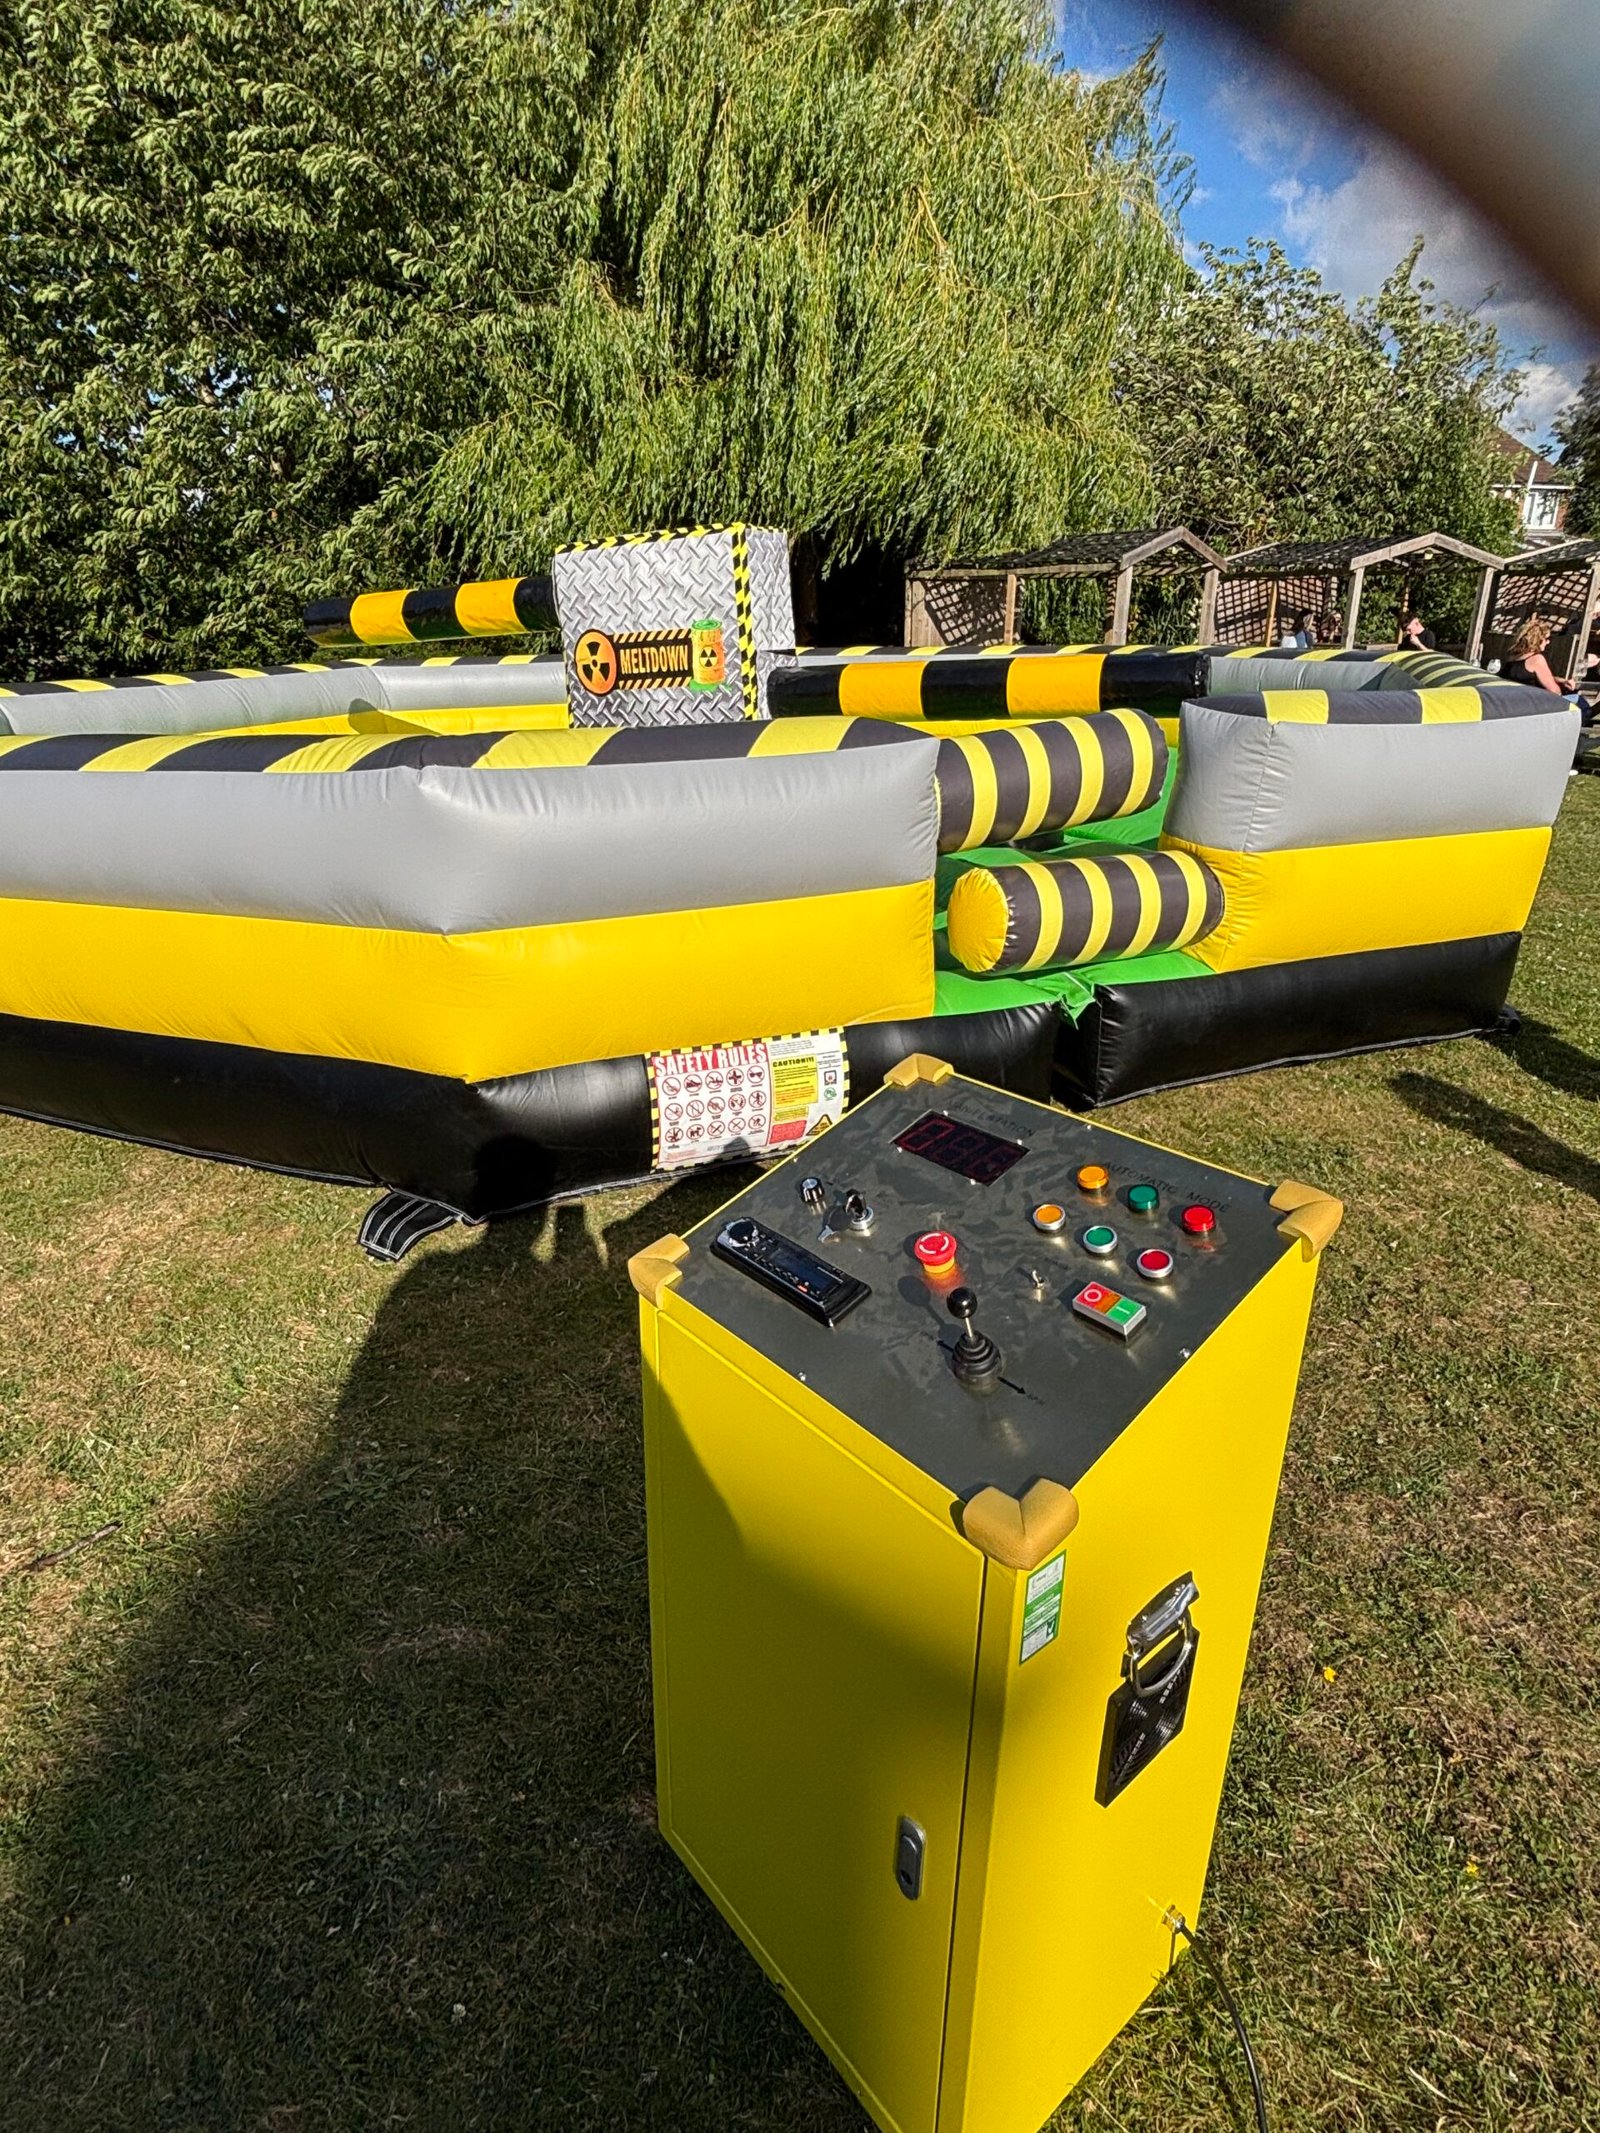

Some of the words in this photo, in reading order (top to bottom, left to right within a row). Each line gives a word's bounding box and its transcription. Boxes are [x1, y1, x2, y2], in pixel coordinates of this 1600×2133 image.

[620, 646, 689, 675] MELTDOWN
[654, 1052, 713, 1077] SAFETY
[716, 1043, 767, 1068] RULES
[1103, 1161, 1178, 1195] AUTOMATIC
[1186, 1190, 1232, 1214] MODE
